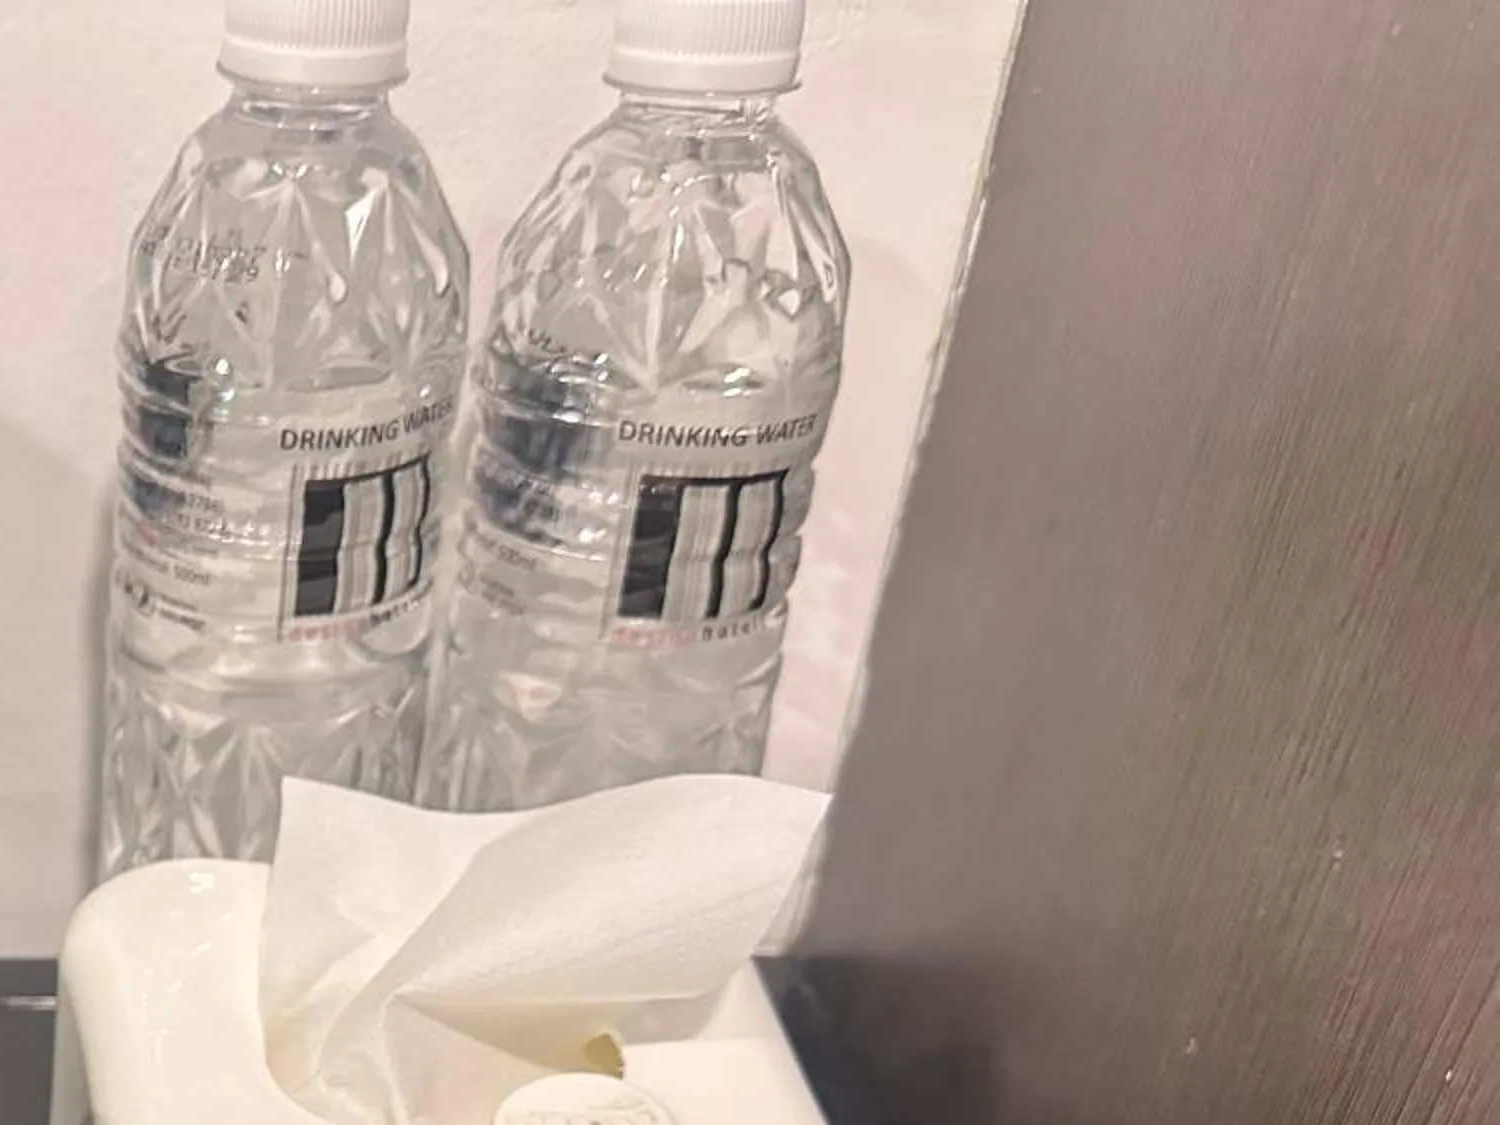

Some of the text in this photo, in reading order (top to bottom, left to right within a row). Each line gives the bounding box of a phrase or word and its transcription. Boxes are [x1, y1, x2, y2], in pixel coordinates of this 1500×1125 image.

[280, 419, 398, 450] DRINKING
[619, 414, 817, 448] DRINKING WATER
